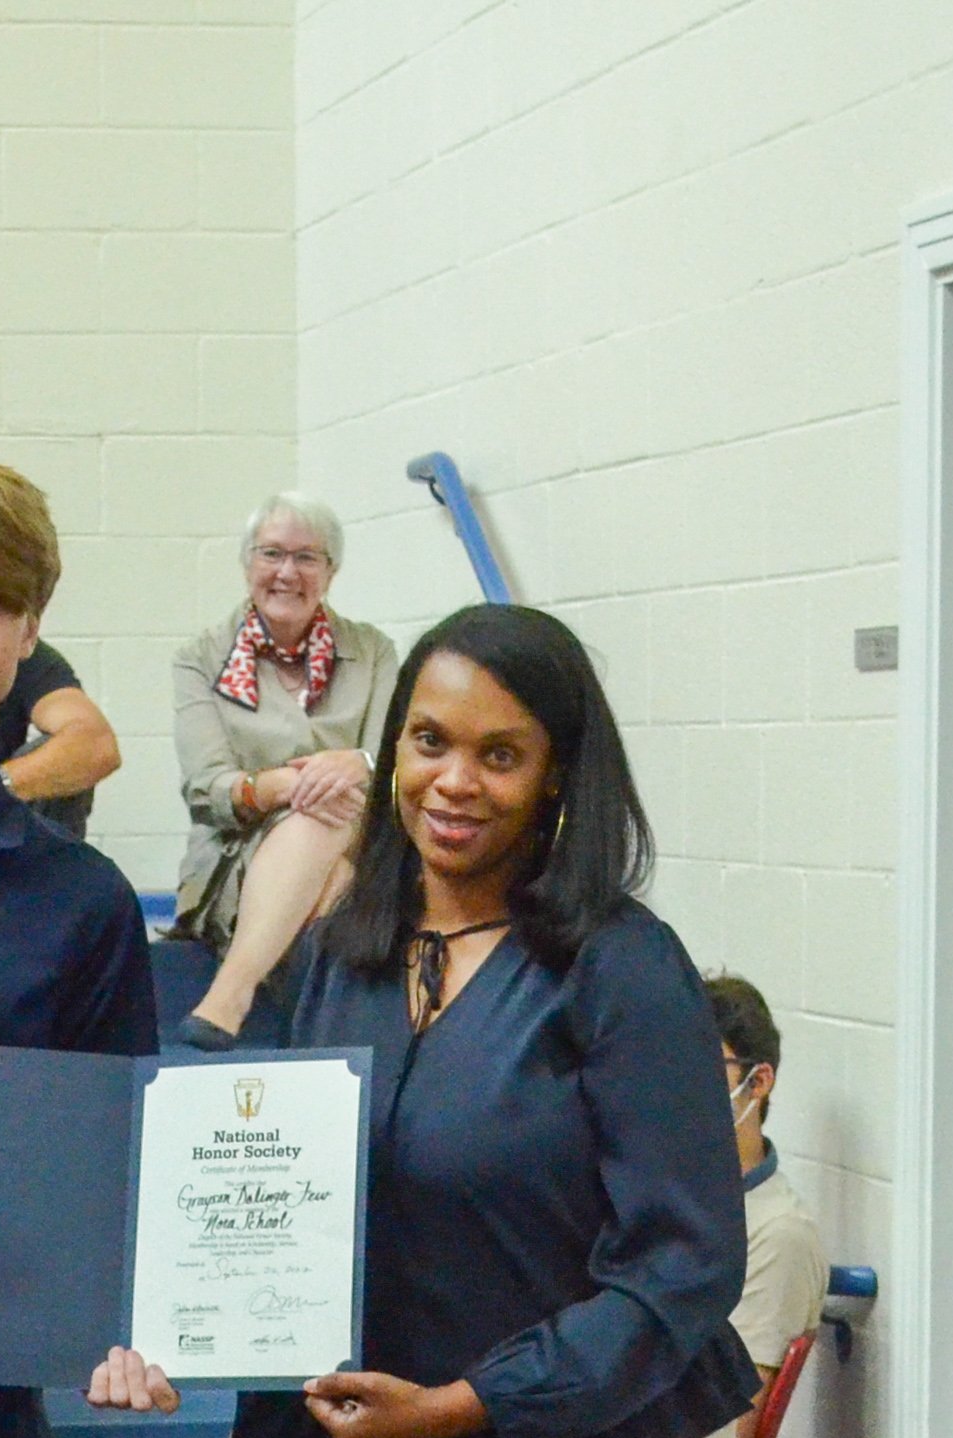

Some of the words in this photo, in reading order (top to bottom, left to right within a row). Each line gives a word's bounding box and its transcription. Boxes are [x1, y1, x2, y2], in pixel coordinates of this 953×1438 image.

[213, 1128, 280, 1143] National
[192, 1147, 240, 1160] Honor
[244, 1144, 301, 1160] Society
